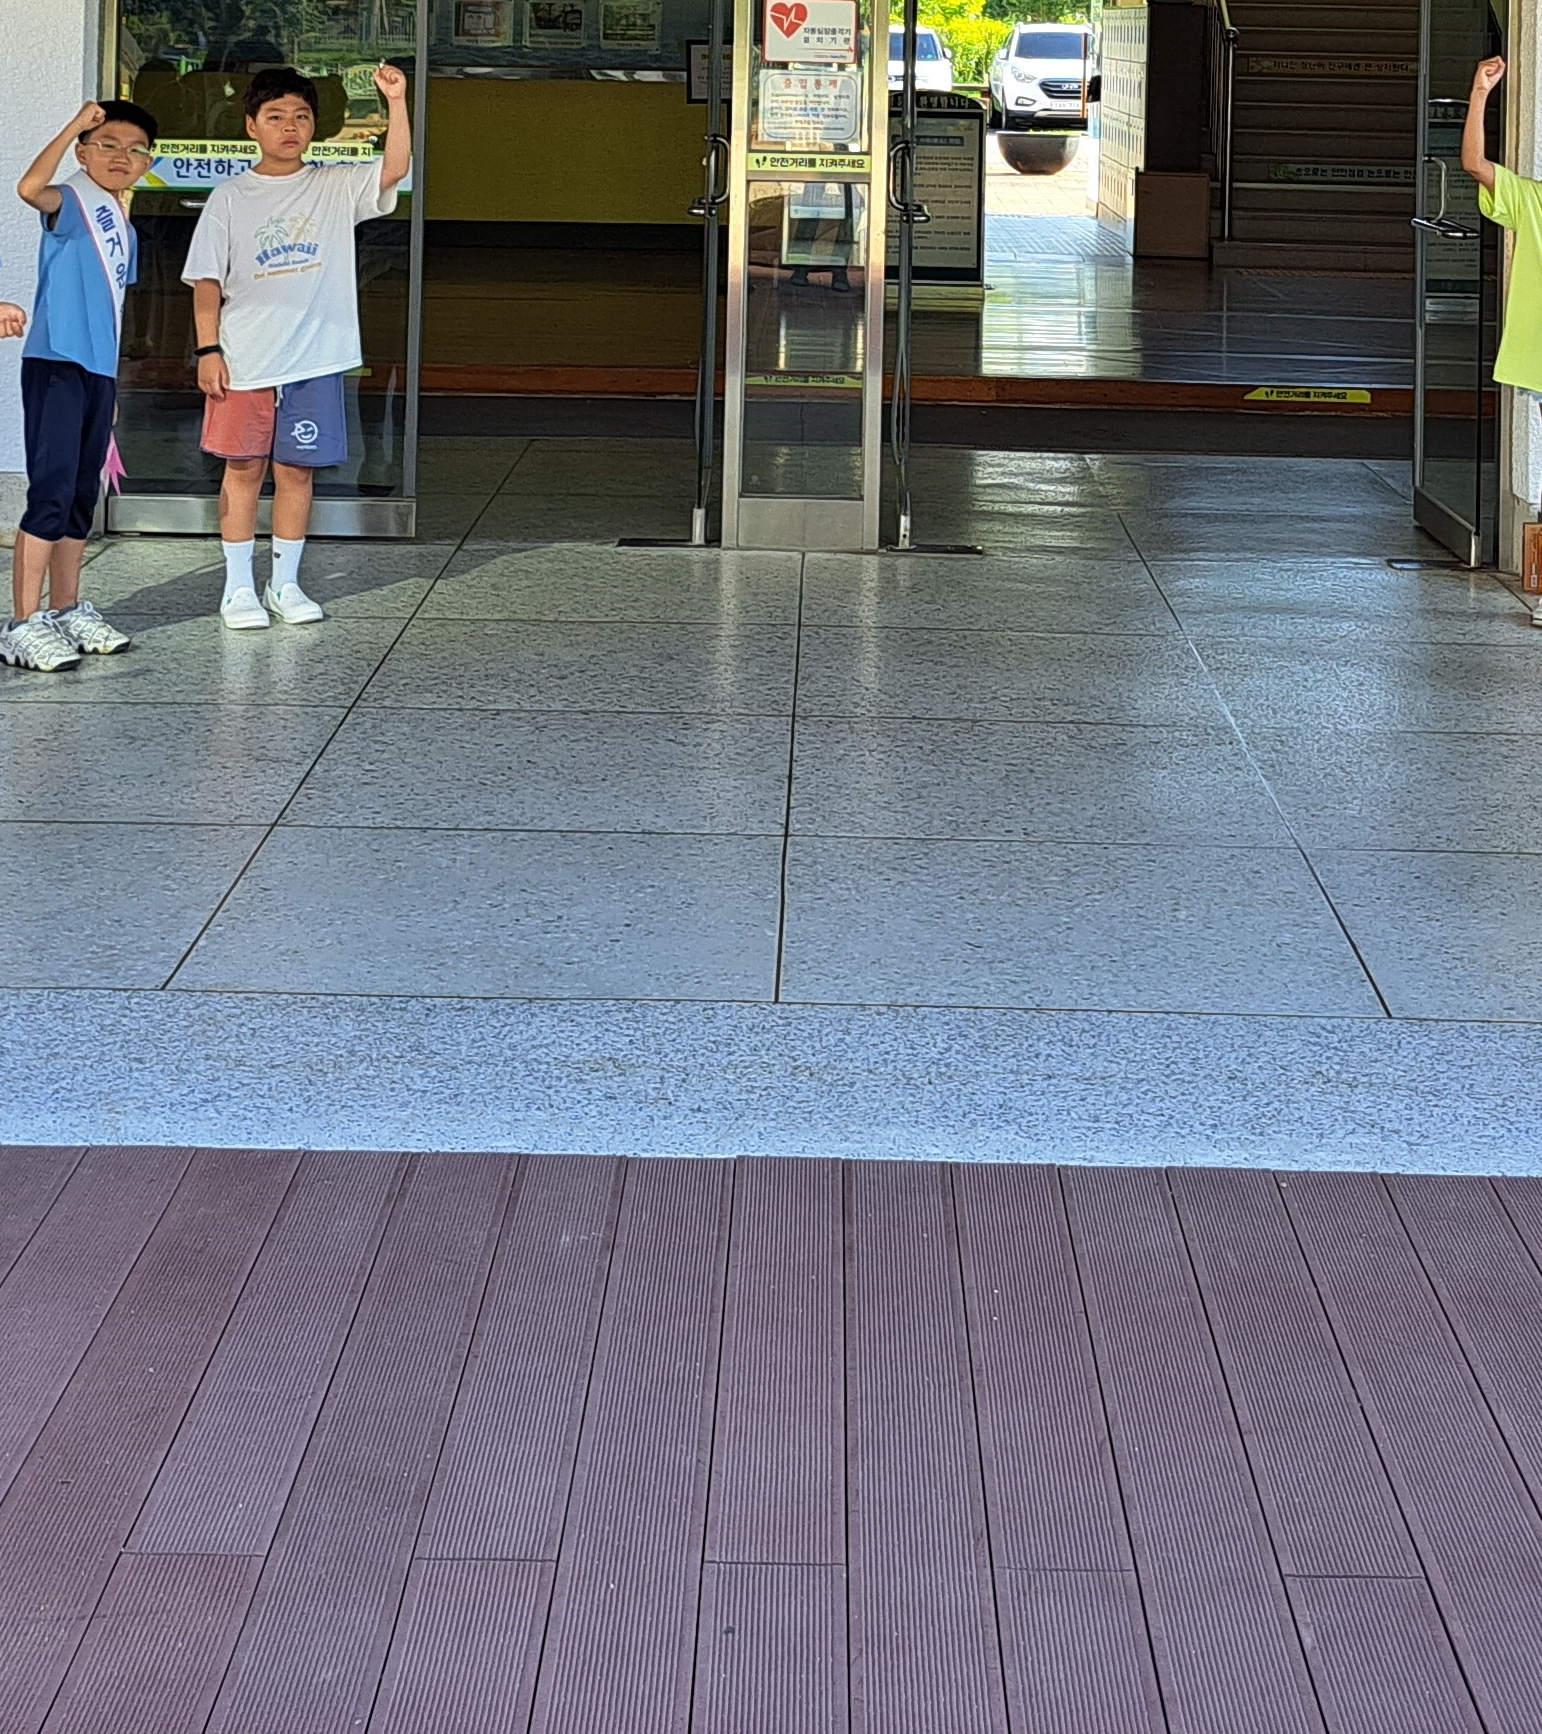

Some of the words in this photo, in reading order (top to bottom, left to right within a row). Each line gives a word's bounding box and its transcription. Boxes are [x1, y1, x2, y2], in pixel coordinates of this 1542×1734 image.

[159, 143, 207, 155] 안전거리를
[210, 143, 258, 156] 지켜주세요
[311, 145, 358, 157] 안전거리를
[173, 157, 252, 180] 안전하고
[770, 156, 817, 169] 안전거리를
[819, 157, 866, 169] 지켜주세요
[95, 204, 127, 290] 즐거운
